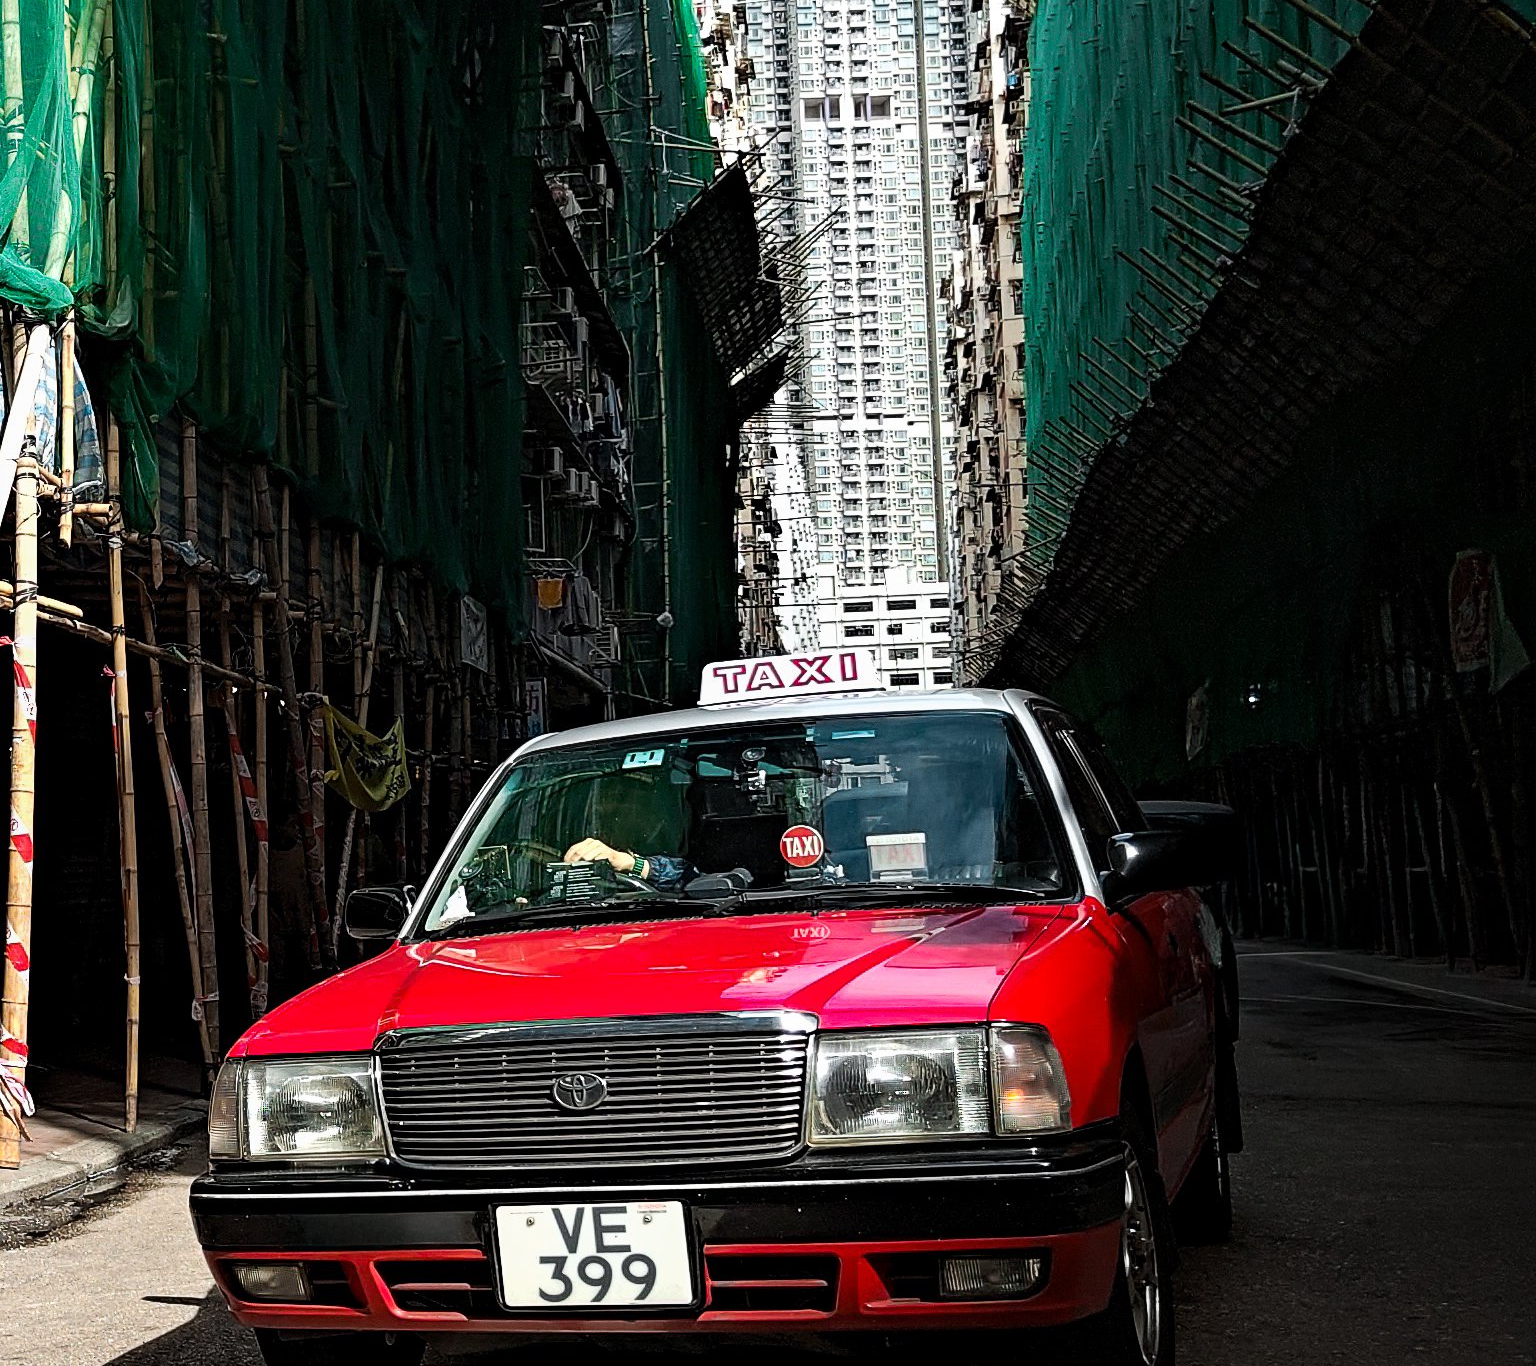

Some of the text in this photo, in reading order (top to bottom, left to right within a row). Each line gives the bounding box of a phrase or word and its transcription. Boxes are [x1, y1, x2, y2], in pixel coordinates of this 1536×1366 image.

[713, 652, 859, 694] TAXI
[782, 835, 821, 858] TAXI
[551, 1205, 632, 1254] VE
[538, 1253, 657, 1303] 399
